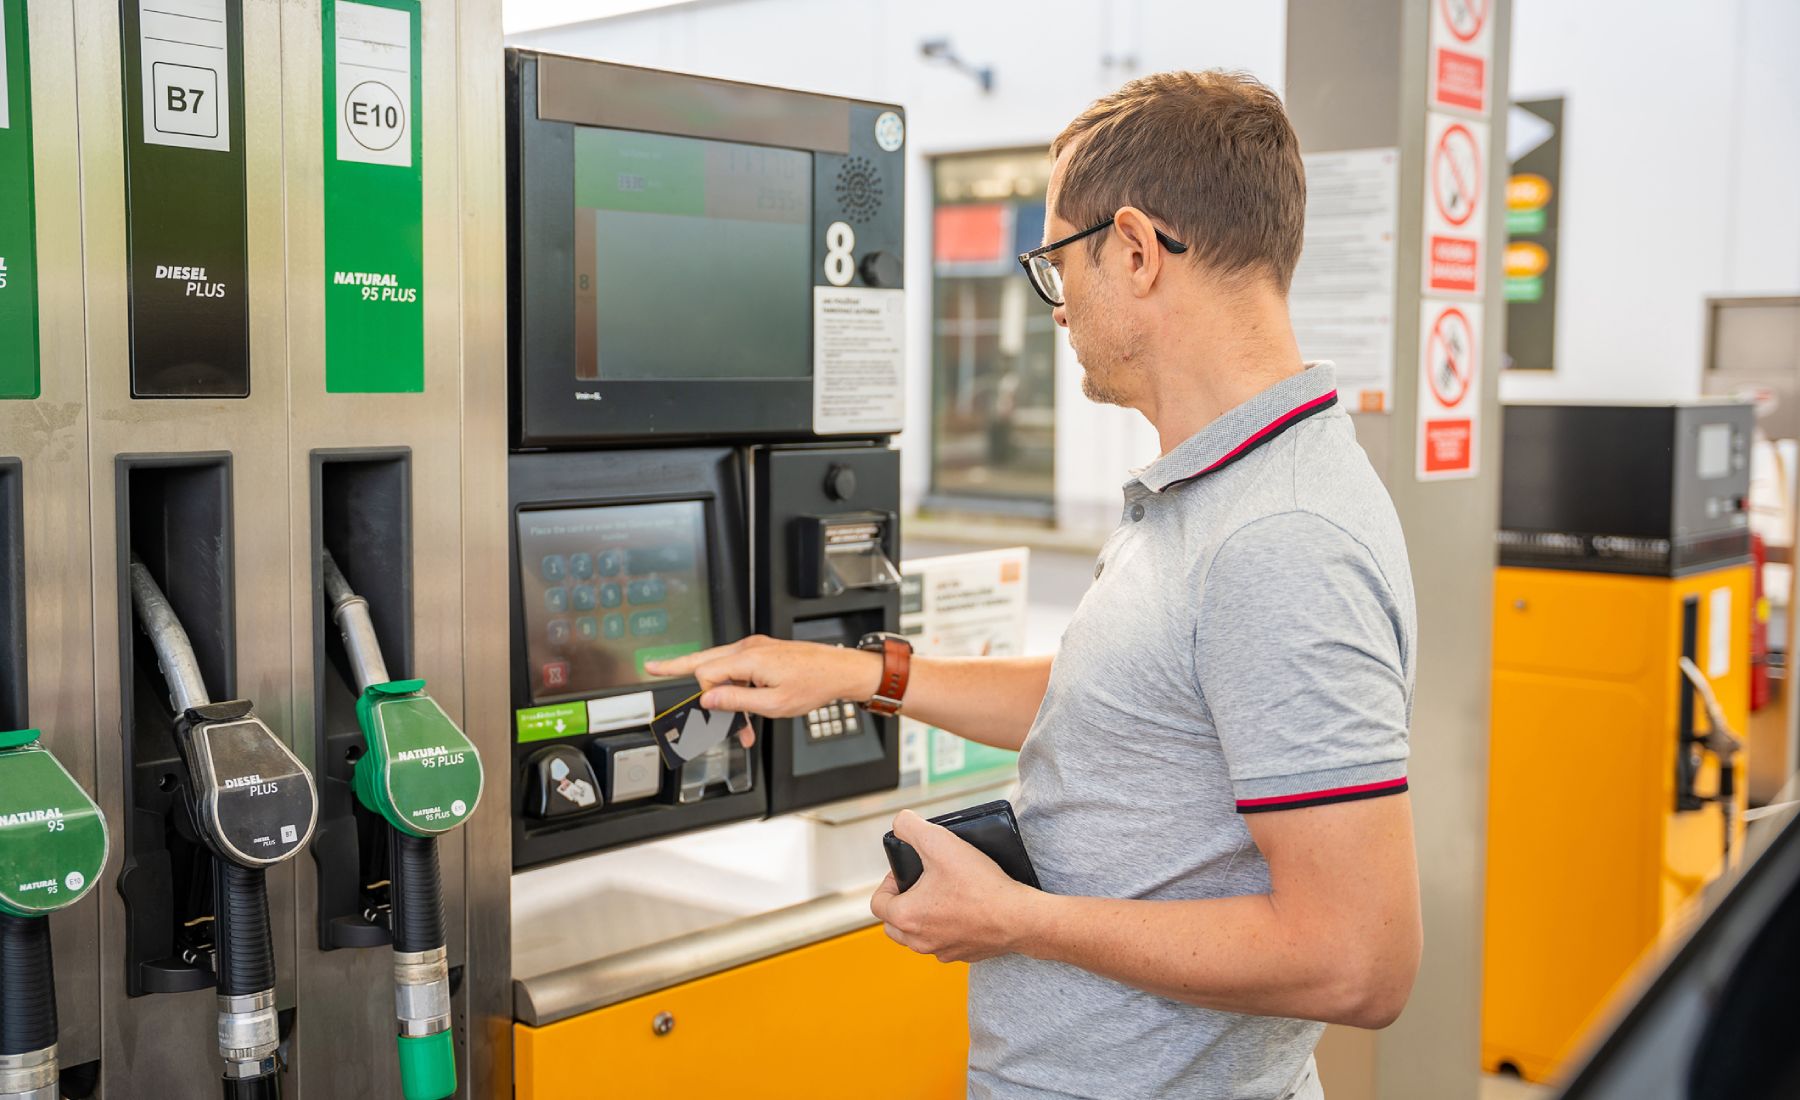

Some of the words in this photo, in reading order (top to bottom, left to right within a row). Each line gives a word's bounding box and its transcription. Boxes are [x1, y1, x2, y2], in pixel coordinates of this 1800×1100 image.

[167, 85, 205, 114] B7
[352, 101, 398, 129] E10
[824, 221, 856, 286] 8
[155, 265, 208, 281] DIESEL
[333, 271, 399, 287] NATURAL
[186, 281, 226, 298] PLUS
[361, 286, 379, 301] 95
[381, 287, 417, 303] PLUS
[578, 559, 586, 571] 2
[638, 617, 659, 629] DEL
[398, 745, 449, 761] NATURAL
[421, 757, 436, 769] 95
[437, 752, 465, 768] PLUS
[224, 774, 264, 789] DIESEL
[250, 782, 279, 797] PLUS
[0, 807, 64, 827] NATURAL
[413, 807, 441, 817] NATURAL
[435, 811, 450, 820] PLUS
[47, 819, 65, 833] 95
[19, 879, 57, 891] NATURAL
[47, 886, 58, 894] 95
